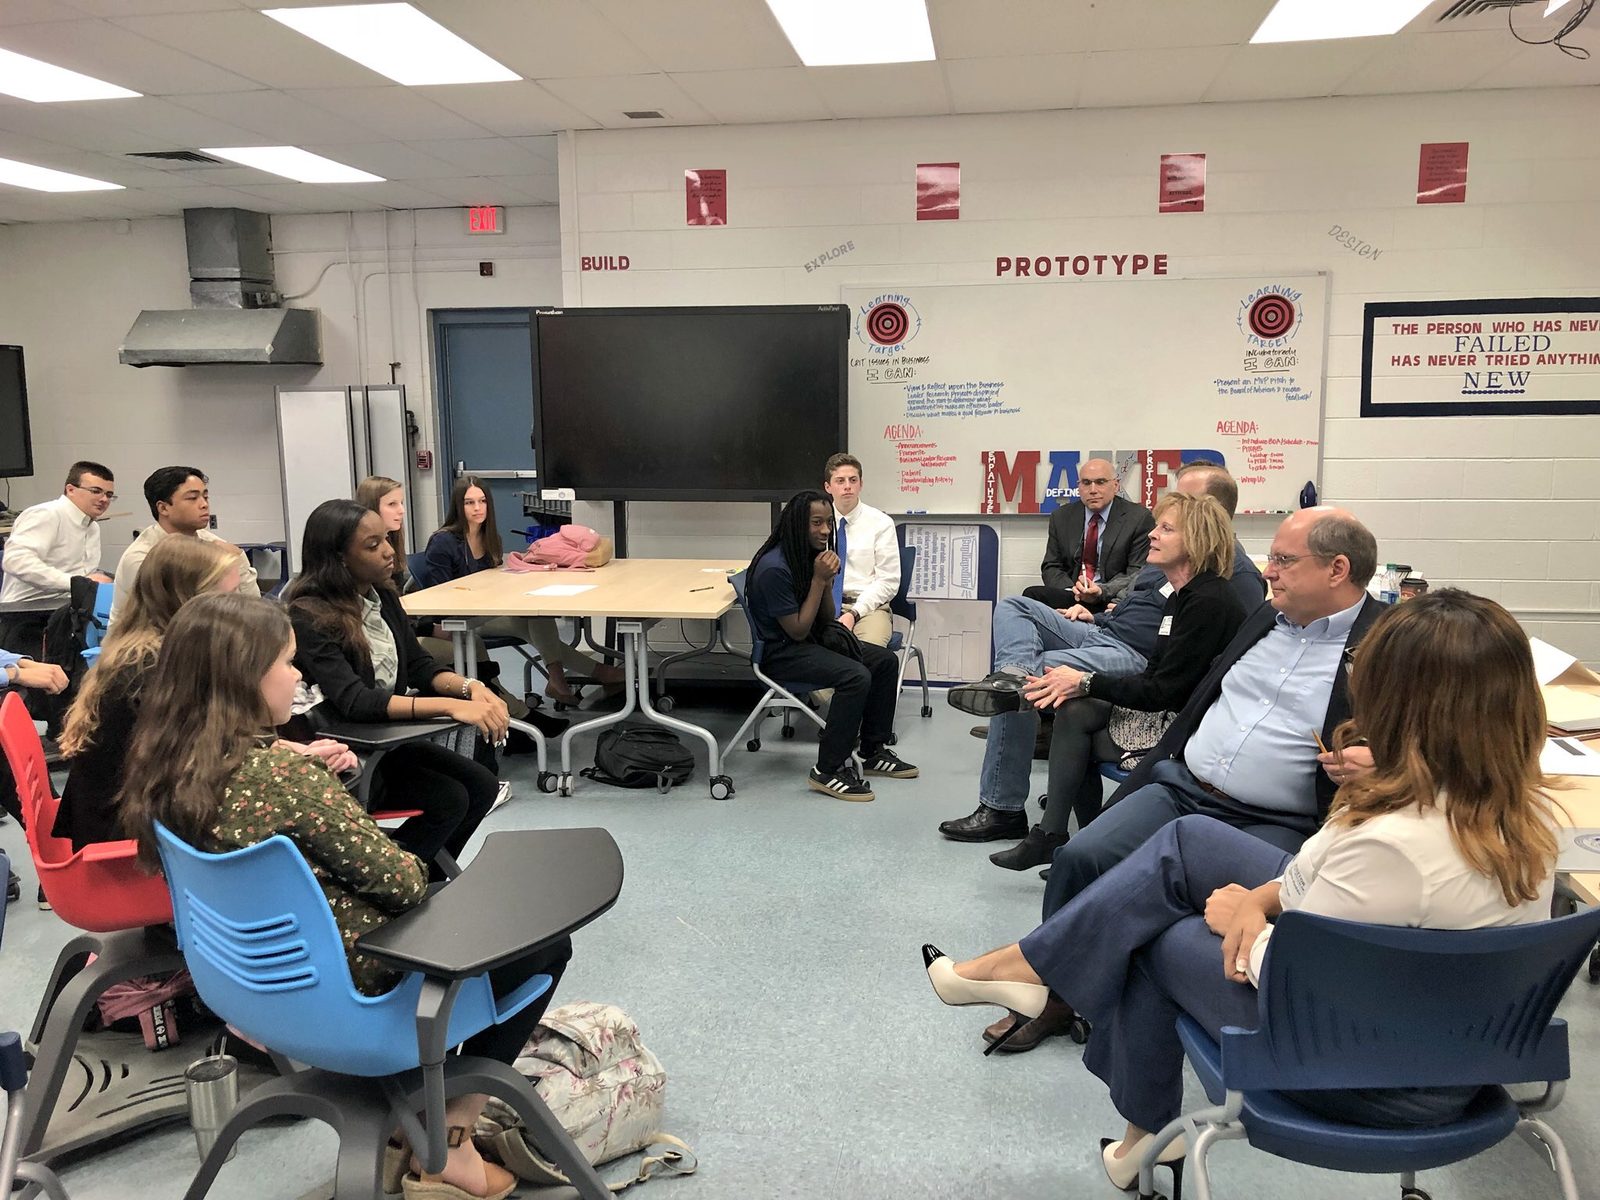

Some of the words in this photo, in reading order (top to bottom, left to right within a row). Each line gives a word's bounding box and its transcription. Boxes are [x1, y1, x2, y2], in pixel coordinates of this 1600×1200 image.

[470, 207, 497, 232] EXIT
[1327, 224, 1384, 261] DESIGN
[581, 256, 630, 271] BUILD
[803, 240, 856, 274] EXPLORE
[996, 254, 1168, 277] PROTOTYPE
[860, 294, 911, 316] Learning
[1392, 323, 1419, 335] THE
[1426, 322, 1482, 334] PERSON
[1492, 321, 1525, 333] WHO
[1533, 320, 1562, 332] HAS
[1569, 319, 1600, 332] NEV
[1247, 333, 1289, 348] TARGET
[1454, 334, 1551, 353] FAILED
[868, 343, 906, 357] Target
[892, 357, 900, 365] IN
[1243, 358, 1258, 371] I
[1264, 356, 1299, 368] CAN:
[1391, 355, 1421, 367] HAS
[1427, 354, 1477, 367] NEVER
[1485, 354, 1530, 366] TRIED
[866, 369, 879, 381] I
[884, 367, 917, 379] CAN:
[1463, 371, 1531, 389] NEW
[1216, 420, 1260, 434] AGENDA:
[987, 452, 996, 515] EMPATHIZE
[1145, 449, 1154, 509] PROTOTYPE
